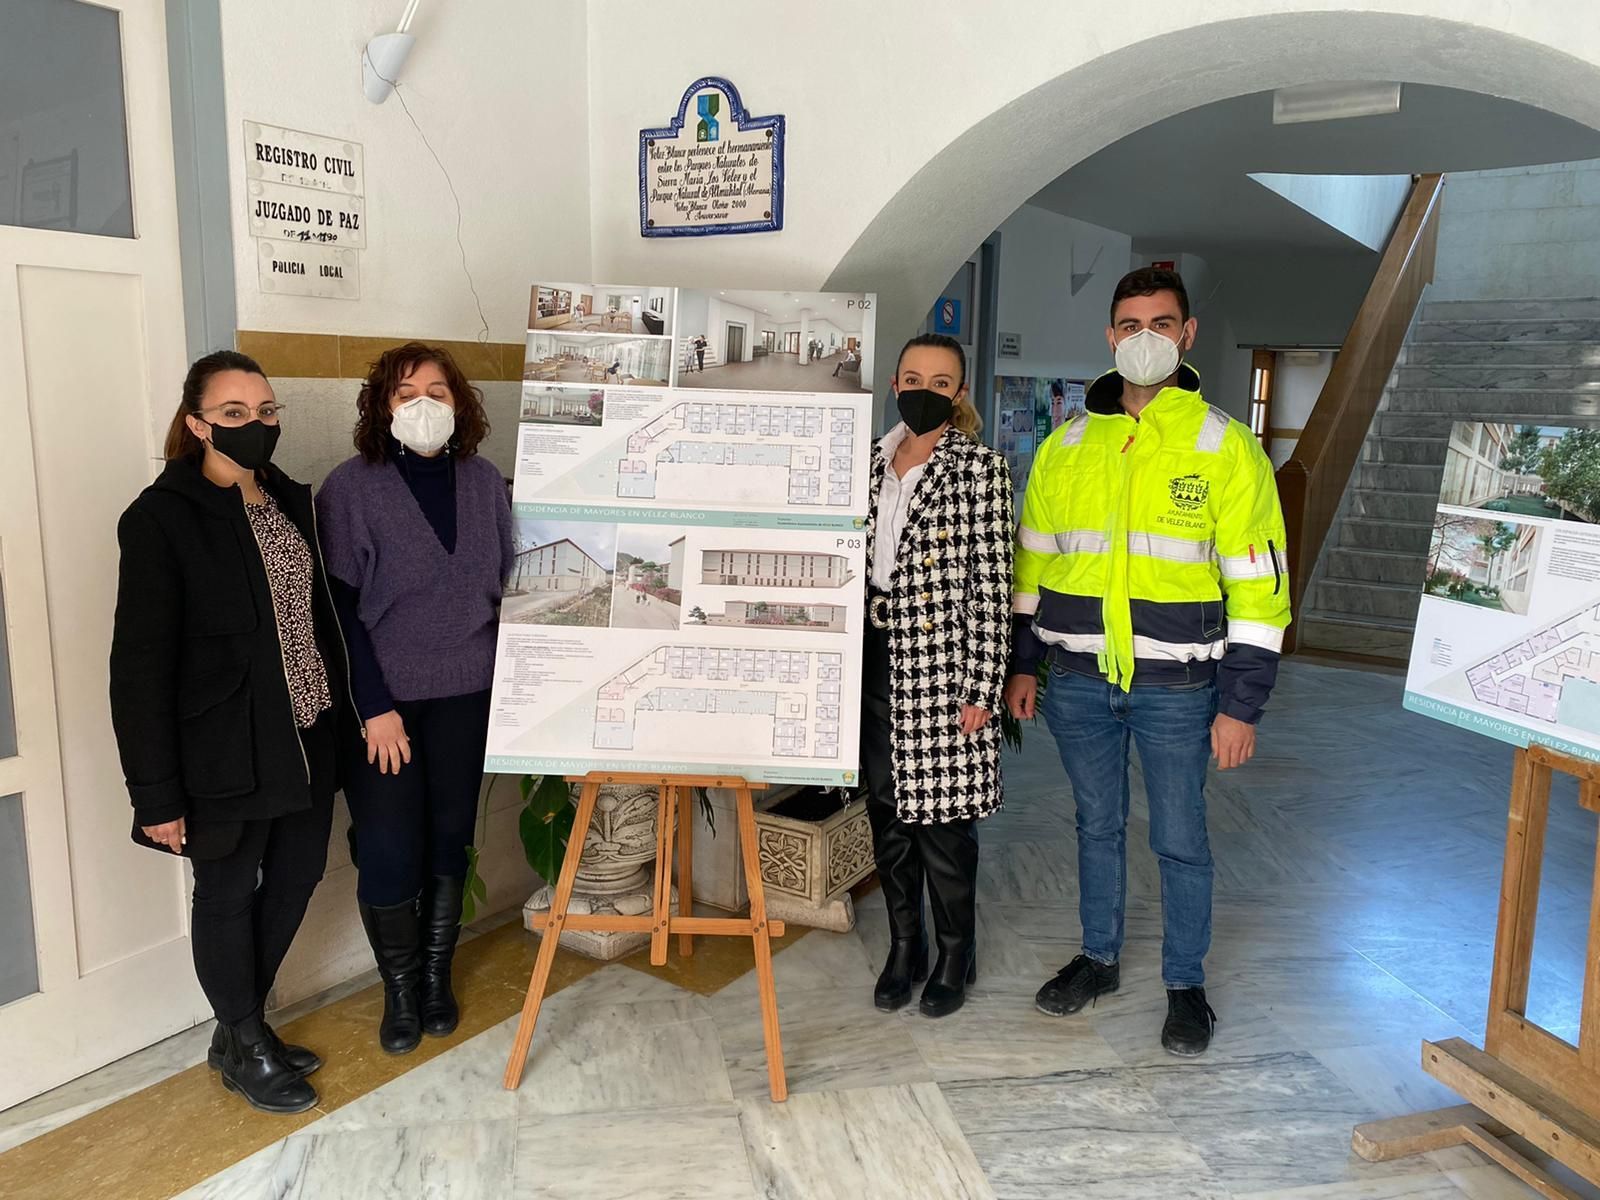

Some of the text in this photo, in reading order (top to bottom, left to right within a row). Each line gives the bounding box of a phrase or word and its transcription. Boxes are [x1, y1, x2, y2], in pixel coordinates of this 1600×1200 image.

[687, 144, 715, 159] pertenece
[717, 140, 726, 155] al
[255, 143, 355, 177] REGISTRO CIVIL
[657, 153, 759, 174] entre los Parques Naturales de
[657, 175, 677, 188] Sierra
[749, 168, 757, 182] el
[649, 189, 673, 203] Parque
[674, 187, 701, 201] Natural
[731, 200, 747, 209] 2000
[255, 200, 360, 230] JUZGADO DE PAZ
[685, 211, 691, 221] X
[272, 260, 344, 279] POLICIA LOCAL
[847, 299, 871, 310] P 02
[517, 505, 568, 514] RESIDENCIA
[569, 507, 582, 515] DE
[583, 508, 627, 518] MAYORES
[628, 510, 640, 518] EN
[1156, 515, 1165, 523] DE
[1185, 520, 1207, 529] BLANCO
[836, 538, 861, 549] P 03
[1408, 695, 1457, 716] RESIDENCIA
[1458, 711, 1471, 721] DE
[1473, 715, 1519, 737] MAYORES
[1520, 730, 1536, 741] EN
[490, 758, 543, 768] RESIDENCIA
[545, 759, 557, 768] DE
[559, 760, 602, 770] MAYORES
